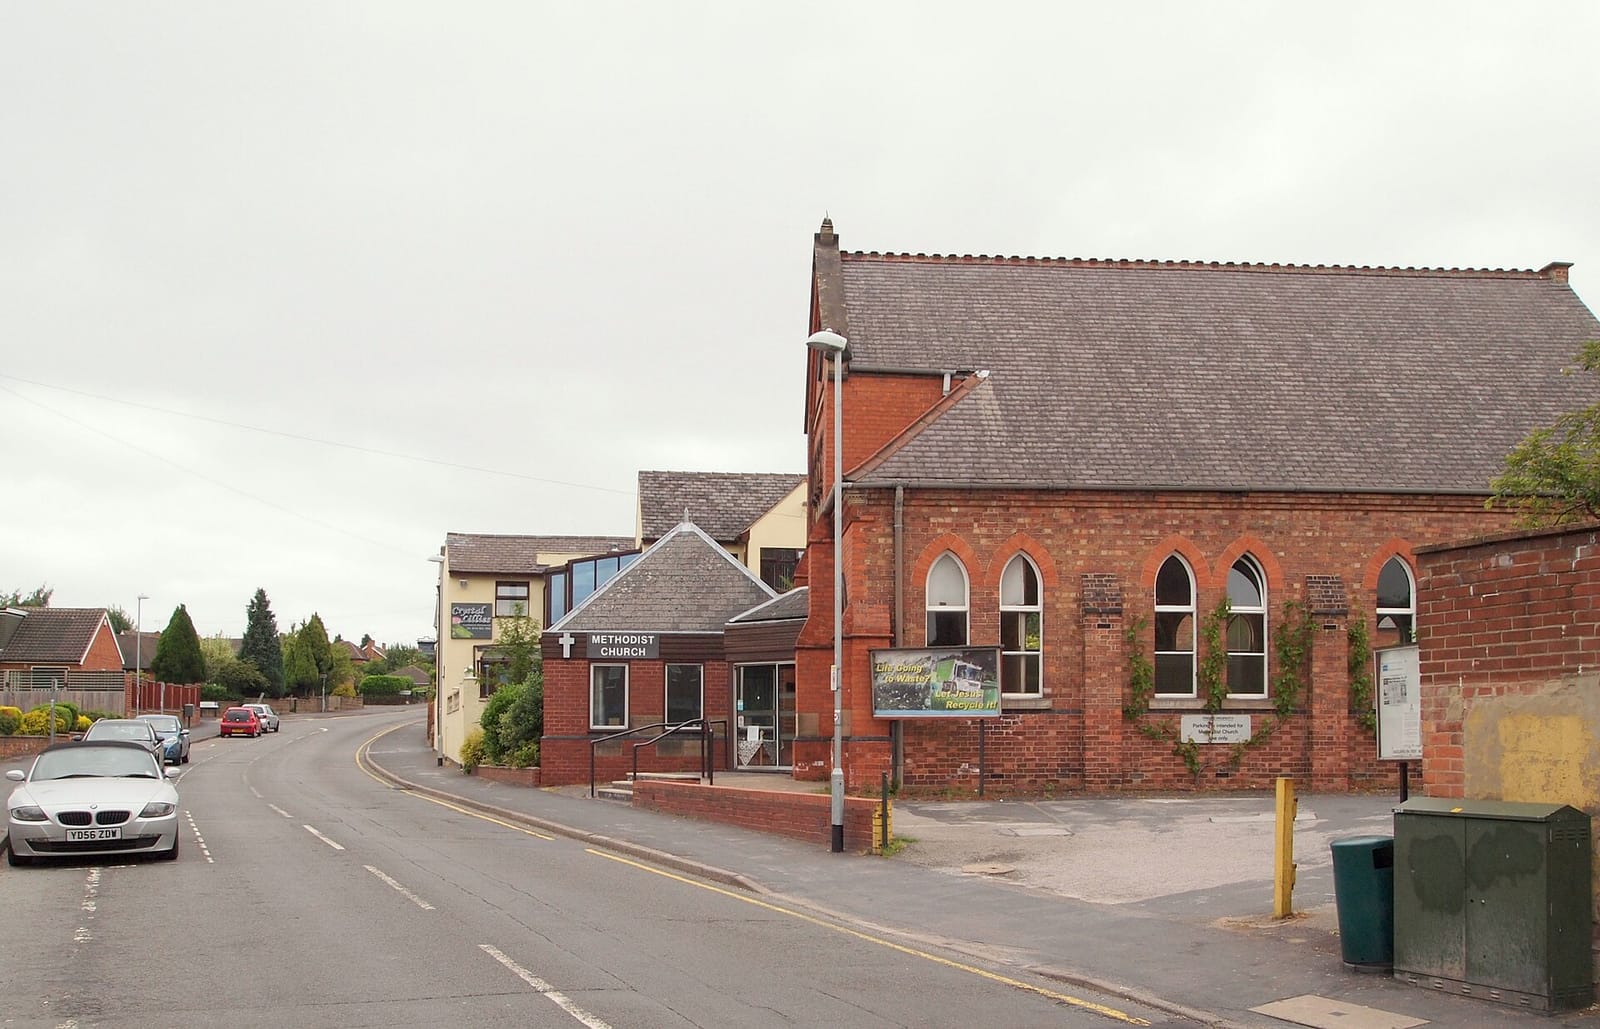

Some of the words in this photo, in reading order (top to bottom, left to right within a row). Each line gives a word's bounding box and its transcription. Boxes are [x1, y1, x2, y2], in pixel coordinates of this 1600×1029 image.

[452, 606, 487, 617] Crystal
[591, 635, 655, 645] METHODIST
[600, 647, 646, 656] CHURCH
[876, 663, 893, 673] Life
[895, 663, 924, 673] Going
[885, 674, 895, 683] to
[896, 675, 931, 684] Waste?
[935, 691, 951, 699] Let
[953, 690, 983, 699] Jesus
[945, 701, 984, 710] Recycle
[71, 830, 96, 840] YD56
[98, 829, 117, 839] ZDW
